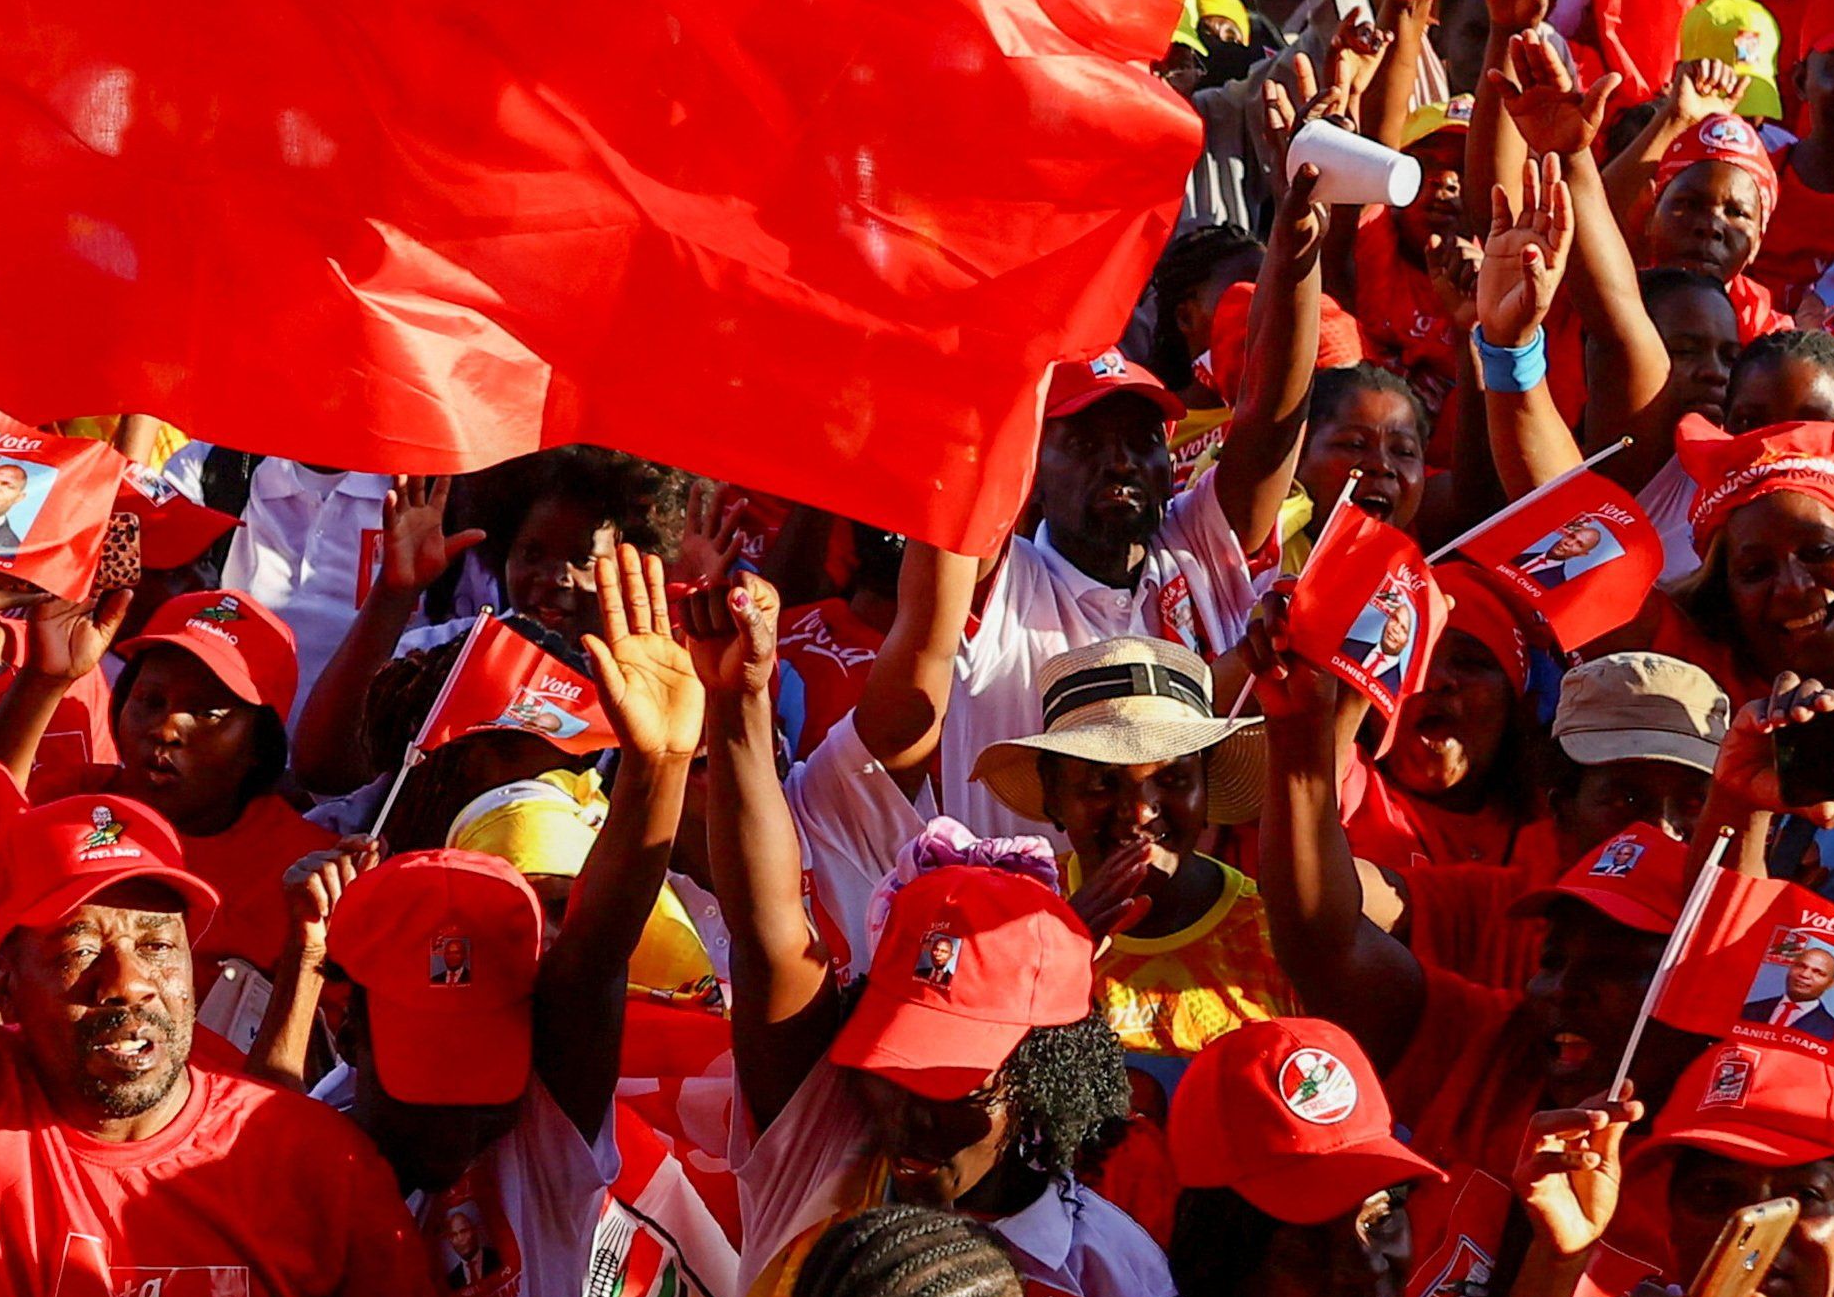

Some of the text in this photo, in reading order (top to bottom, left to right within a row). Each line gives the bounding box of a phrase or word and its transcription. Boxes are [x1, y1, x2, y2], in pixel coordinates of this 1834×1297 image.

[1598, 502, 1636, 526] Vota
[1396, 563, 1427, 592] Vota
[186, 617, 239, 645] FRELIMO
[539, 675, 582, 699] Vota
[1331, 654, 1395, 713] DANIEL CHAPO
[79, 845, 141, 861] FRELIMO
[1732, 1023, 1829, 1055] DANIEL CHAPO
